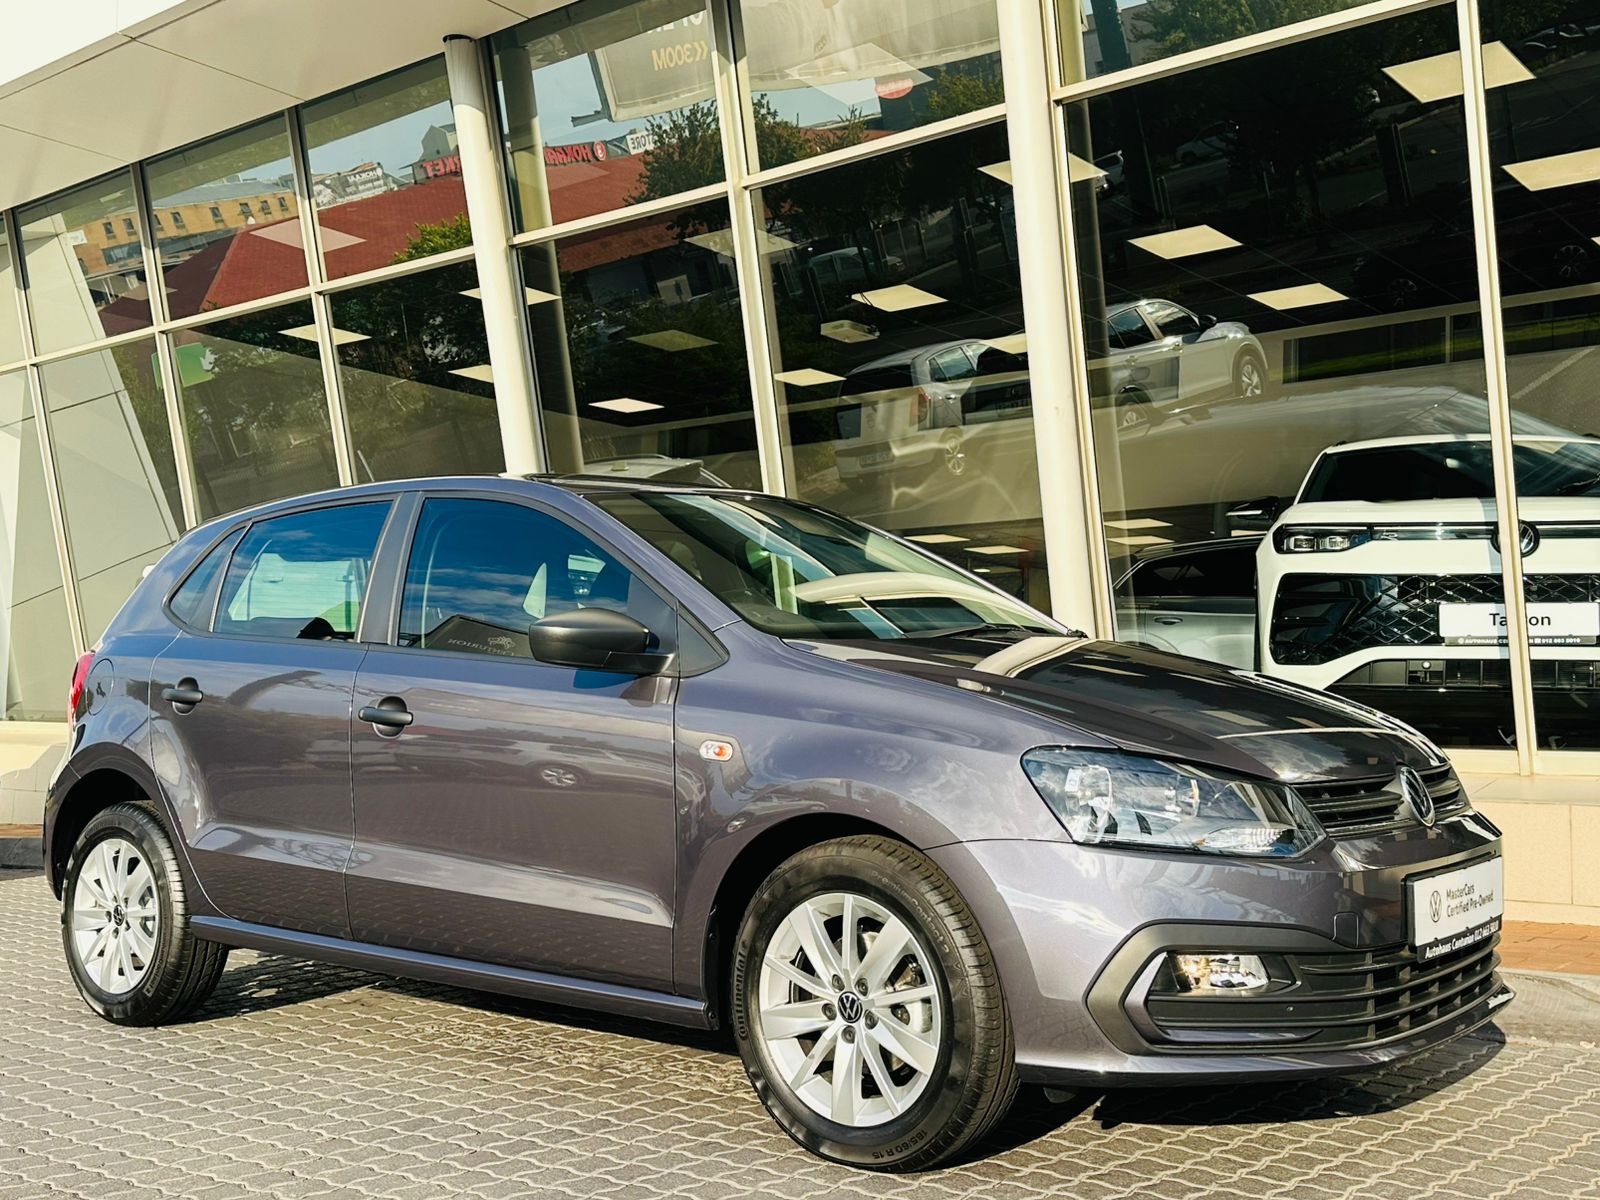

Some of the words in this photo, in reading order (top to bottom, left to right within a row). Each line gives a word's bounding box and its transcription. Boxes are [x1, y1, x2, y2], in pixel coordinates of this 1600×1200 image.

[1489, 613, 1551, 626] Taon
[1446, 883, 1475, 901] MasterCars
[1447, 898, 1469, 917] Certified
[1470, 890, 1493, 910] Pre-Owned
[1425, 942, 1451, 959] Autohaus
[1452, 933, 1474, 950] Centurion
[733, 950, 748, 1041] Continental
[885, 1148, 895, 1157] R
[895, 1130, 928, 1154] 185/60
[872, 1151, 884, 1160] 15
